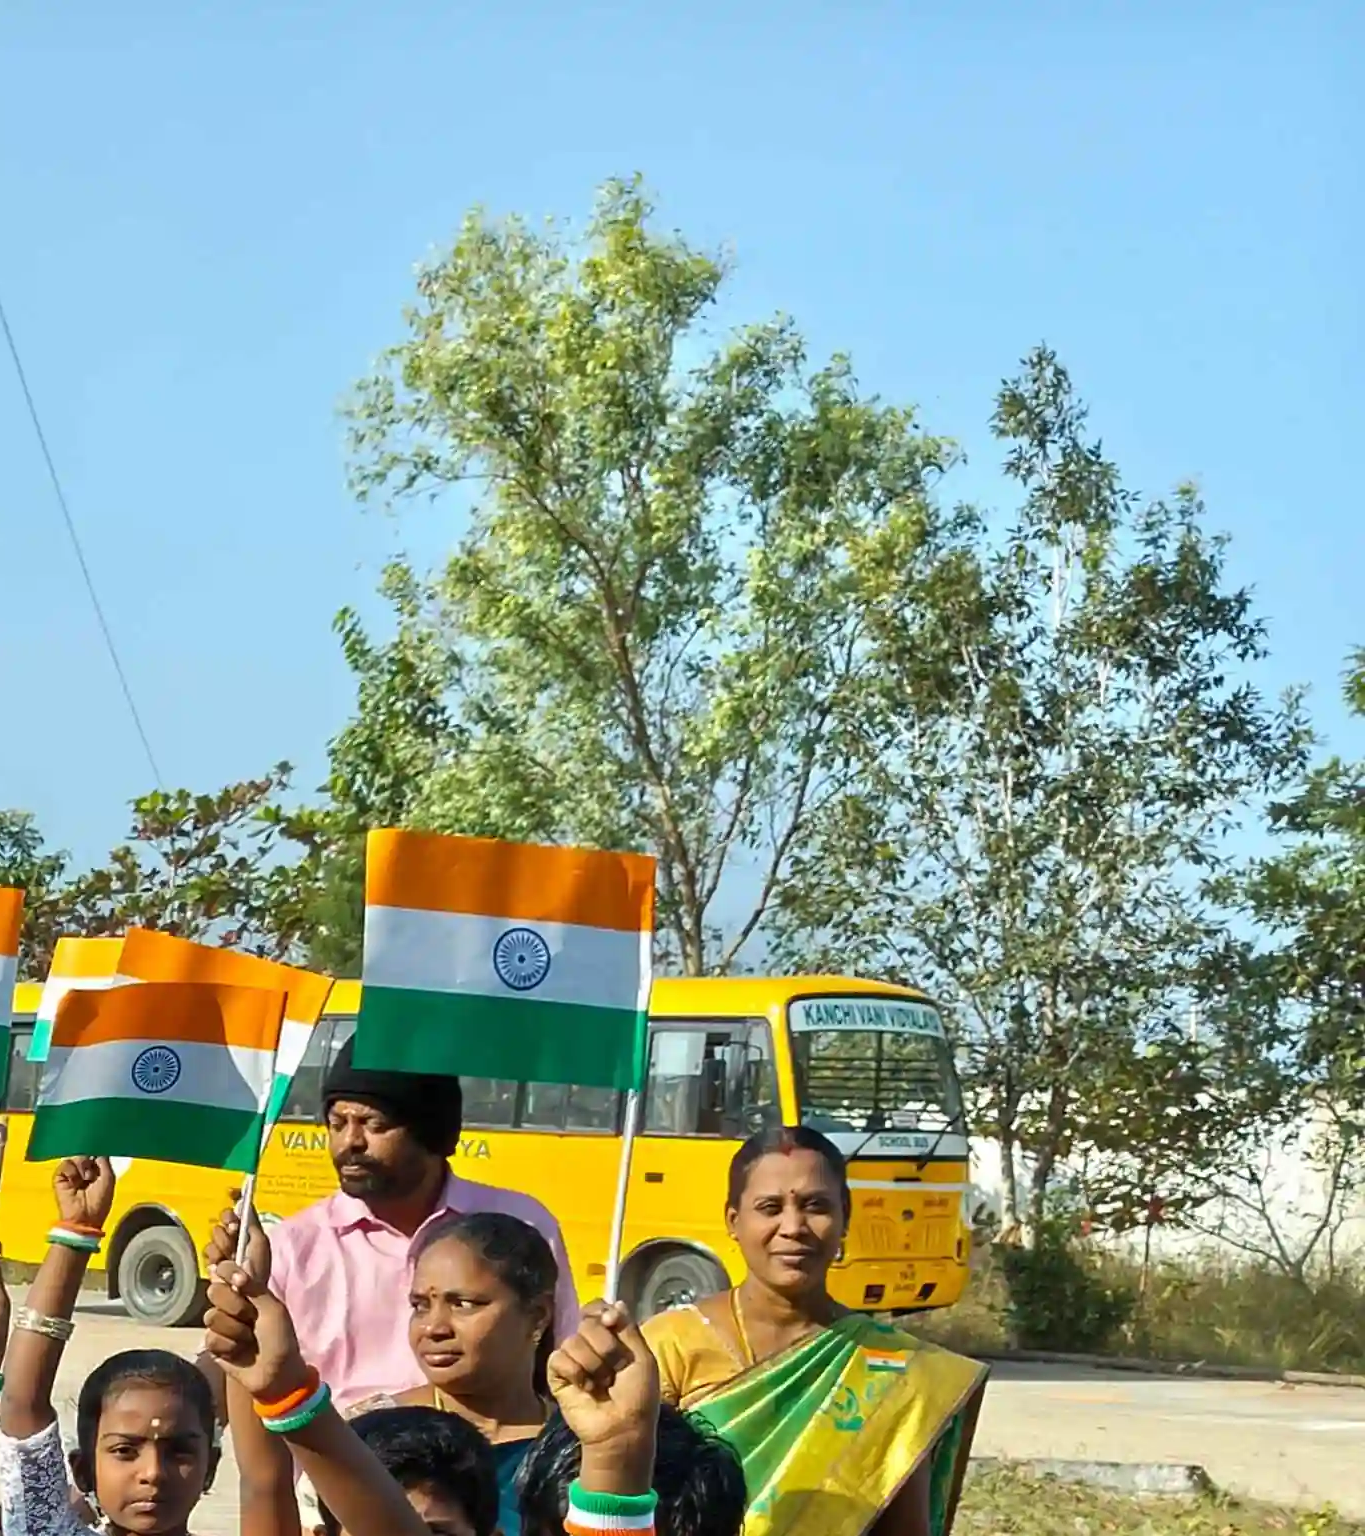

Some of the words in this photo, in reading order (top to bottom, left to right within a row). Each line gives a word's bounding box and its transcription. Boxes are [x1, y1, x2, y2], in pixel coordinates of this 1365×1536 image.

[802, 1002, 853, 1025] KANCHI
[854, 1004, 887, 1026] VANI
[280, 1131, 327, 1151] VAN
[878, 1136, 911, 1148] SCHOOL
